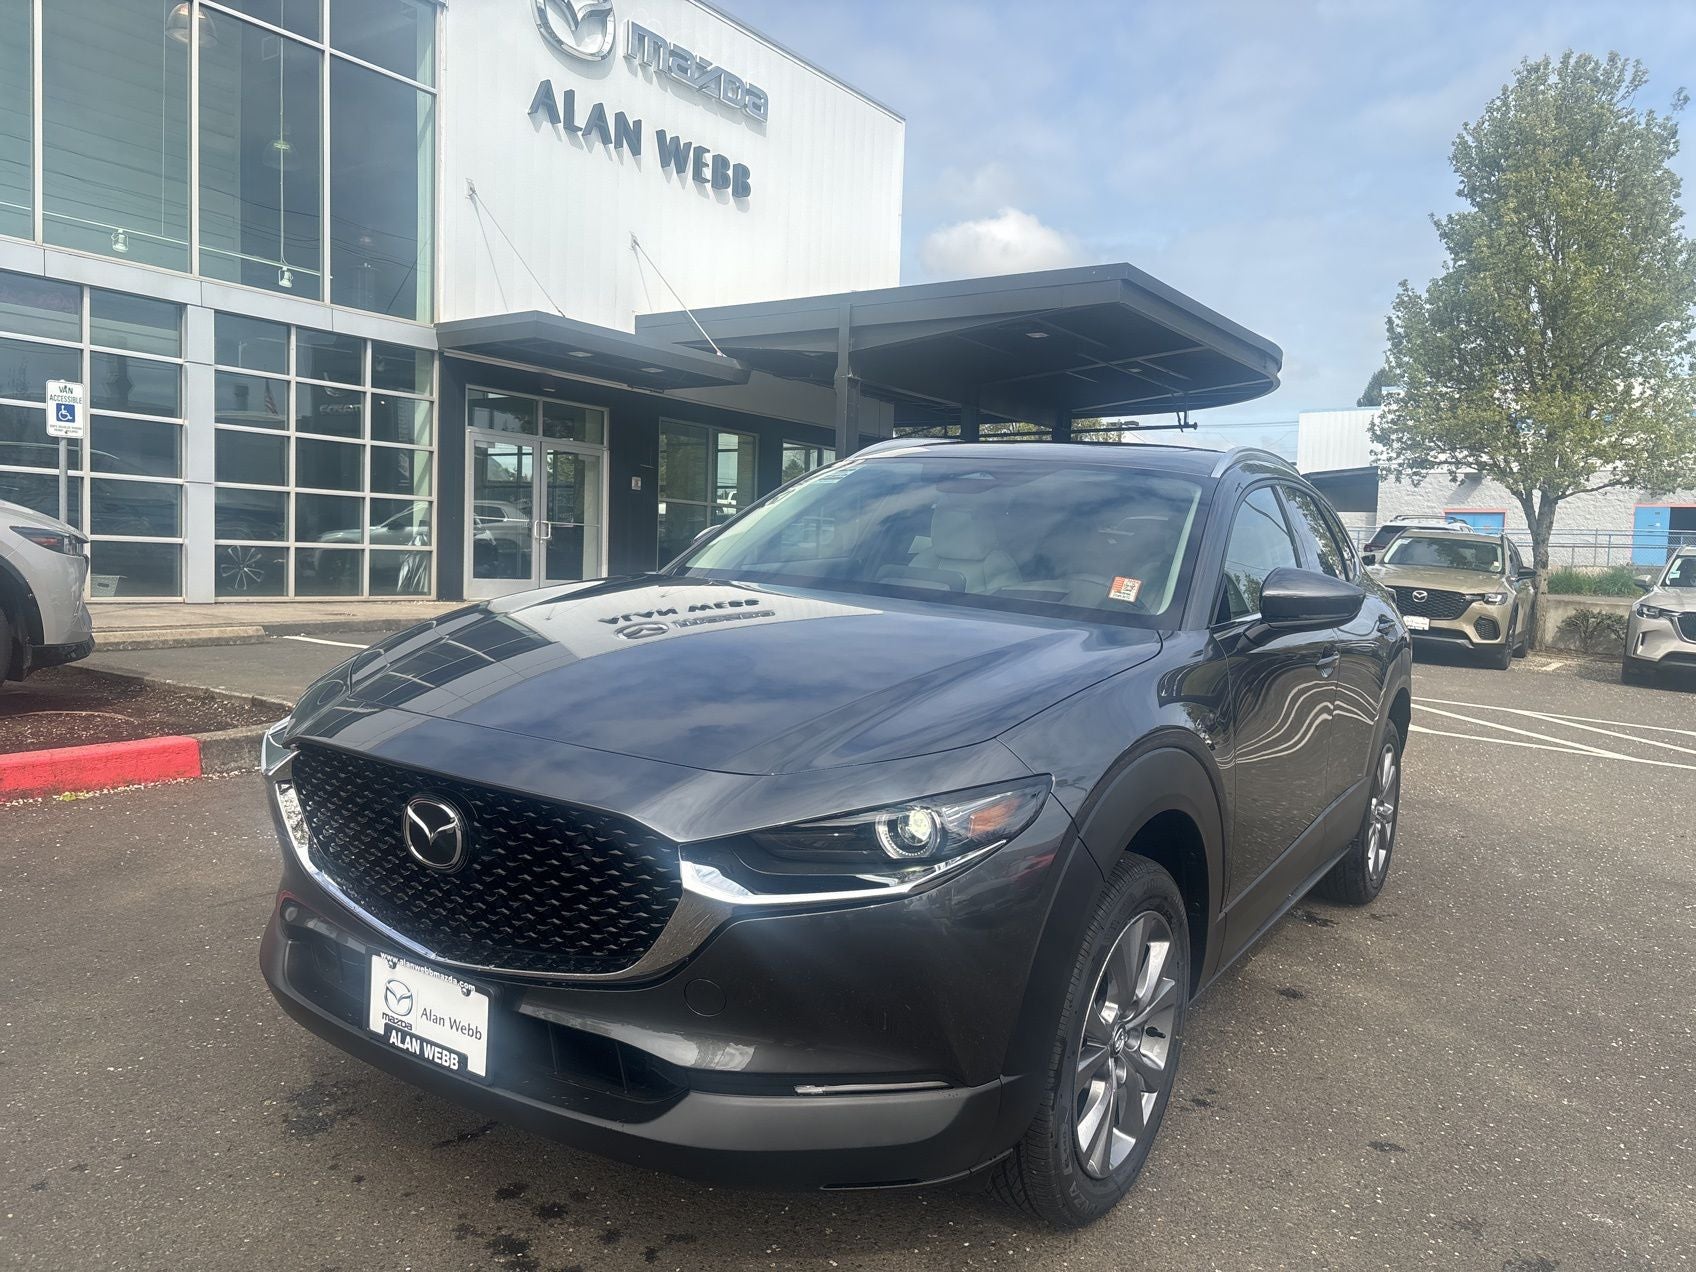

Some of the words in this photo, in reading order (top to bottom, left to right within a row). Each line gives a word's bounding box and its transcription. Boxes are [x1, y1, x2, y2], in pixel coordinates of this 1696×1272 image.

[528, 79, 642, 157] ALAN
[656, 129, 751, 198] WEBB
[50, 394, 82, 404] ACCESSIBLE
[59, 385, 73, 394] VAN
[420, 1008, 445, 1027] Alan
[449, 1017, 482, 1040] Webb
[389, 1030, 420, 1055] ALAN
[423, 1043, 459, 1070] WEBB
